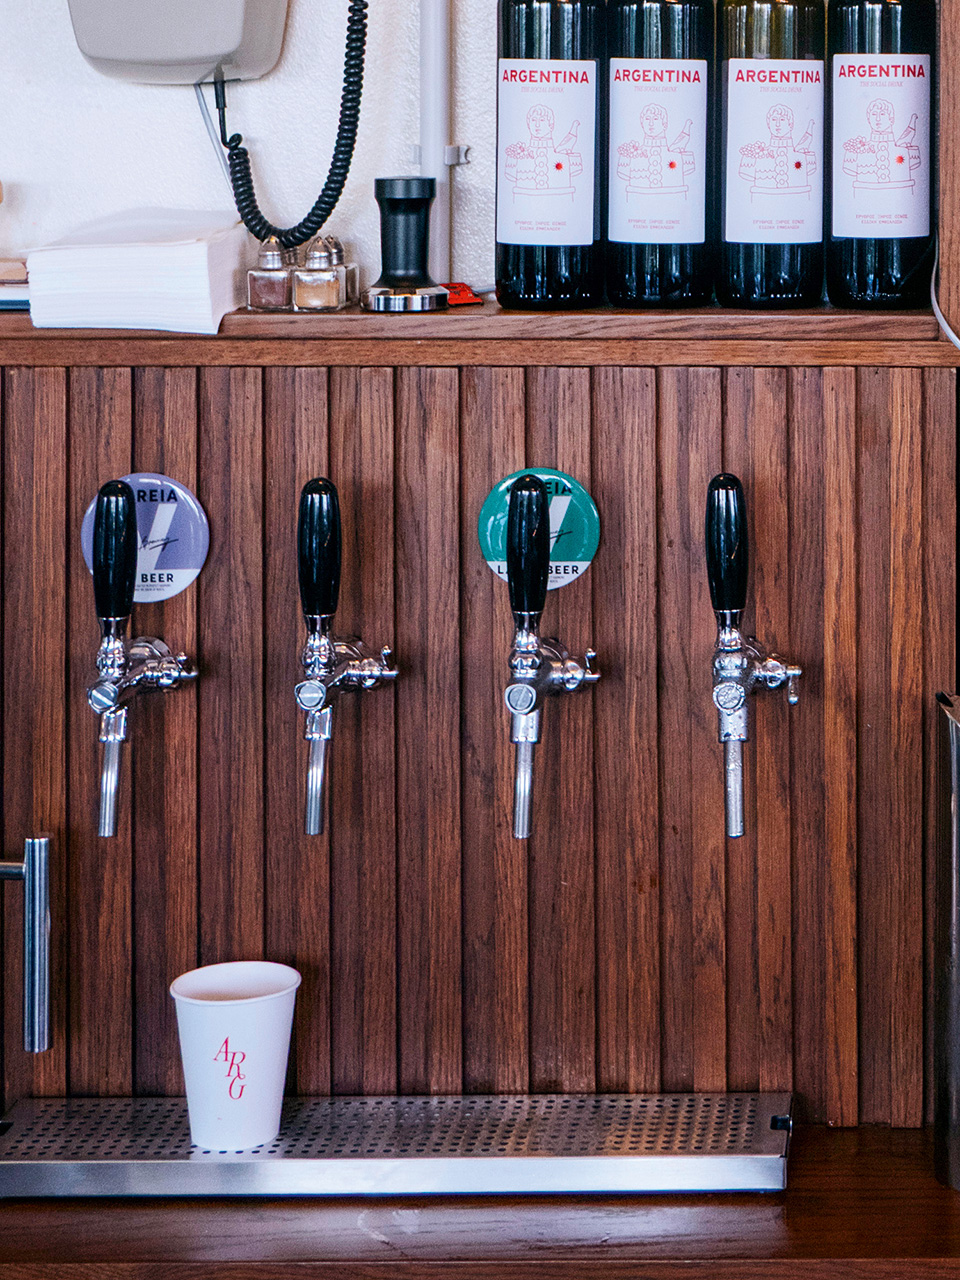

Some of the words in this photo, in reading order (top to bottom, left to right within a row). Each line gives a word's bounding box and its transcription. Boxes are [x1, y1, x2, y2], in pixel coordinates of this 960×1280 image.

[502, 69, 589, 84] ARGENTINA
[614, 69, 701, 83] ARGENTINA
[735, 69, 821, 84] ARGENTINA
[838, 64, 925, 78] ARGENTINA
[137, 489, 178, 502] REIA
[141, 573, 174, 583] BEER
